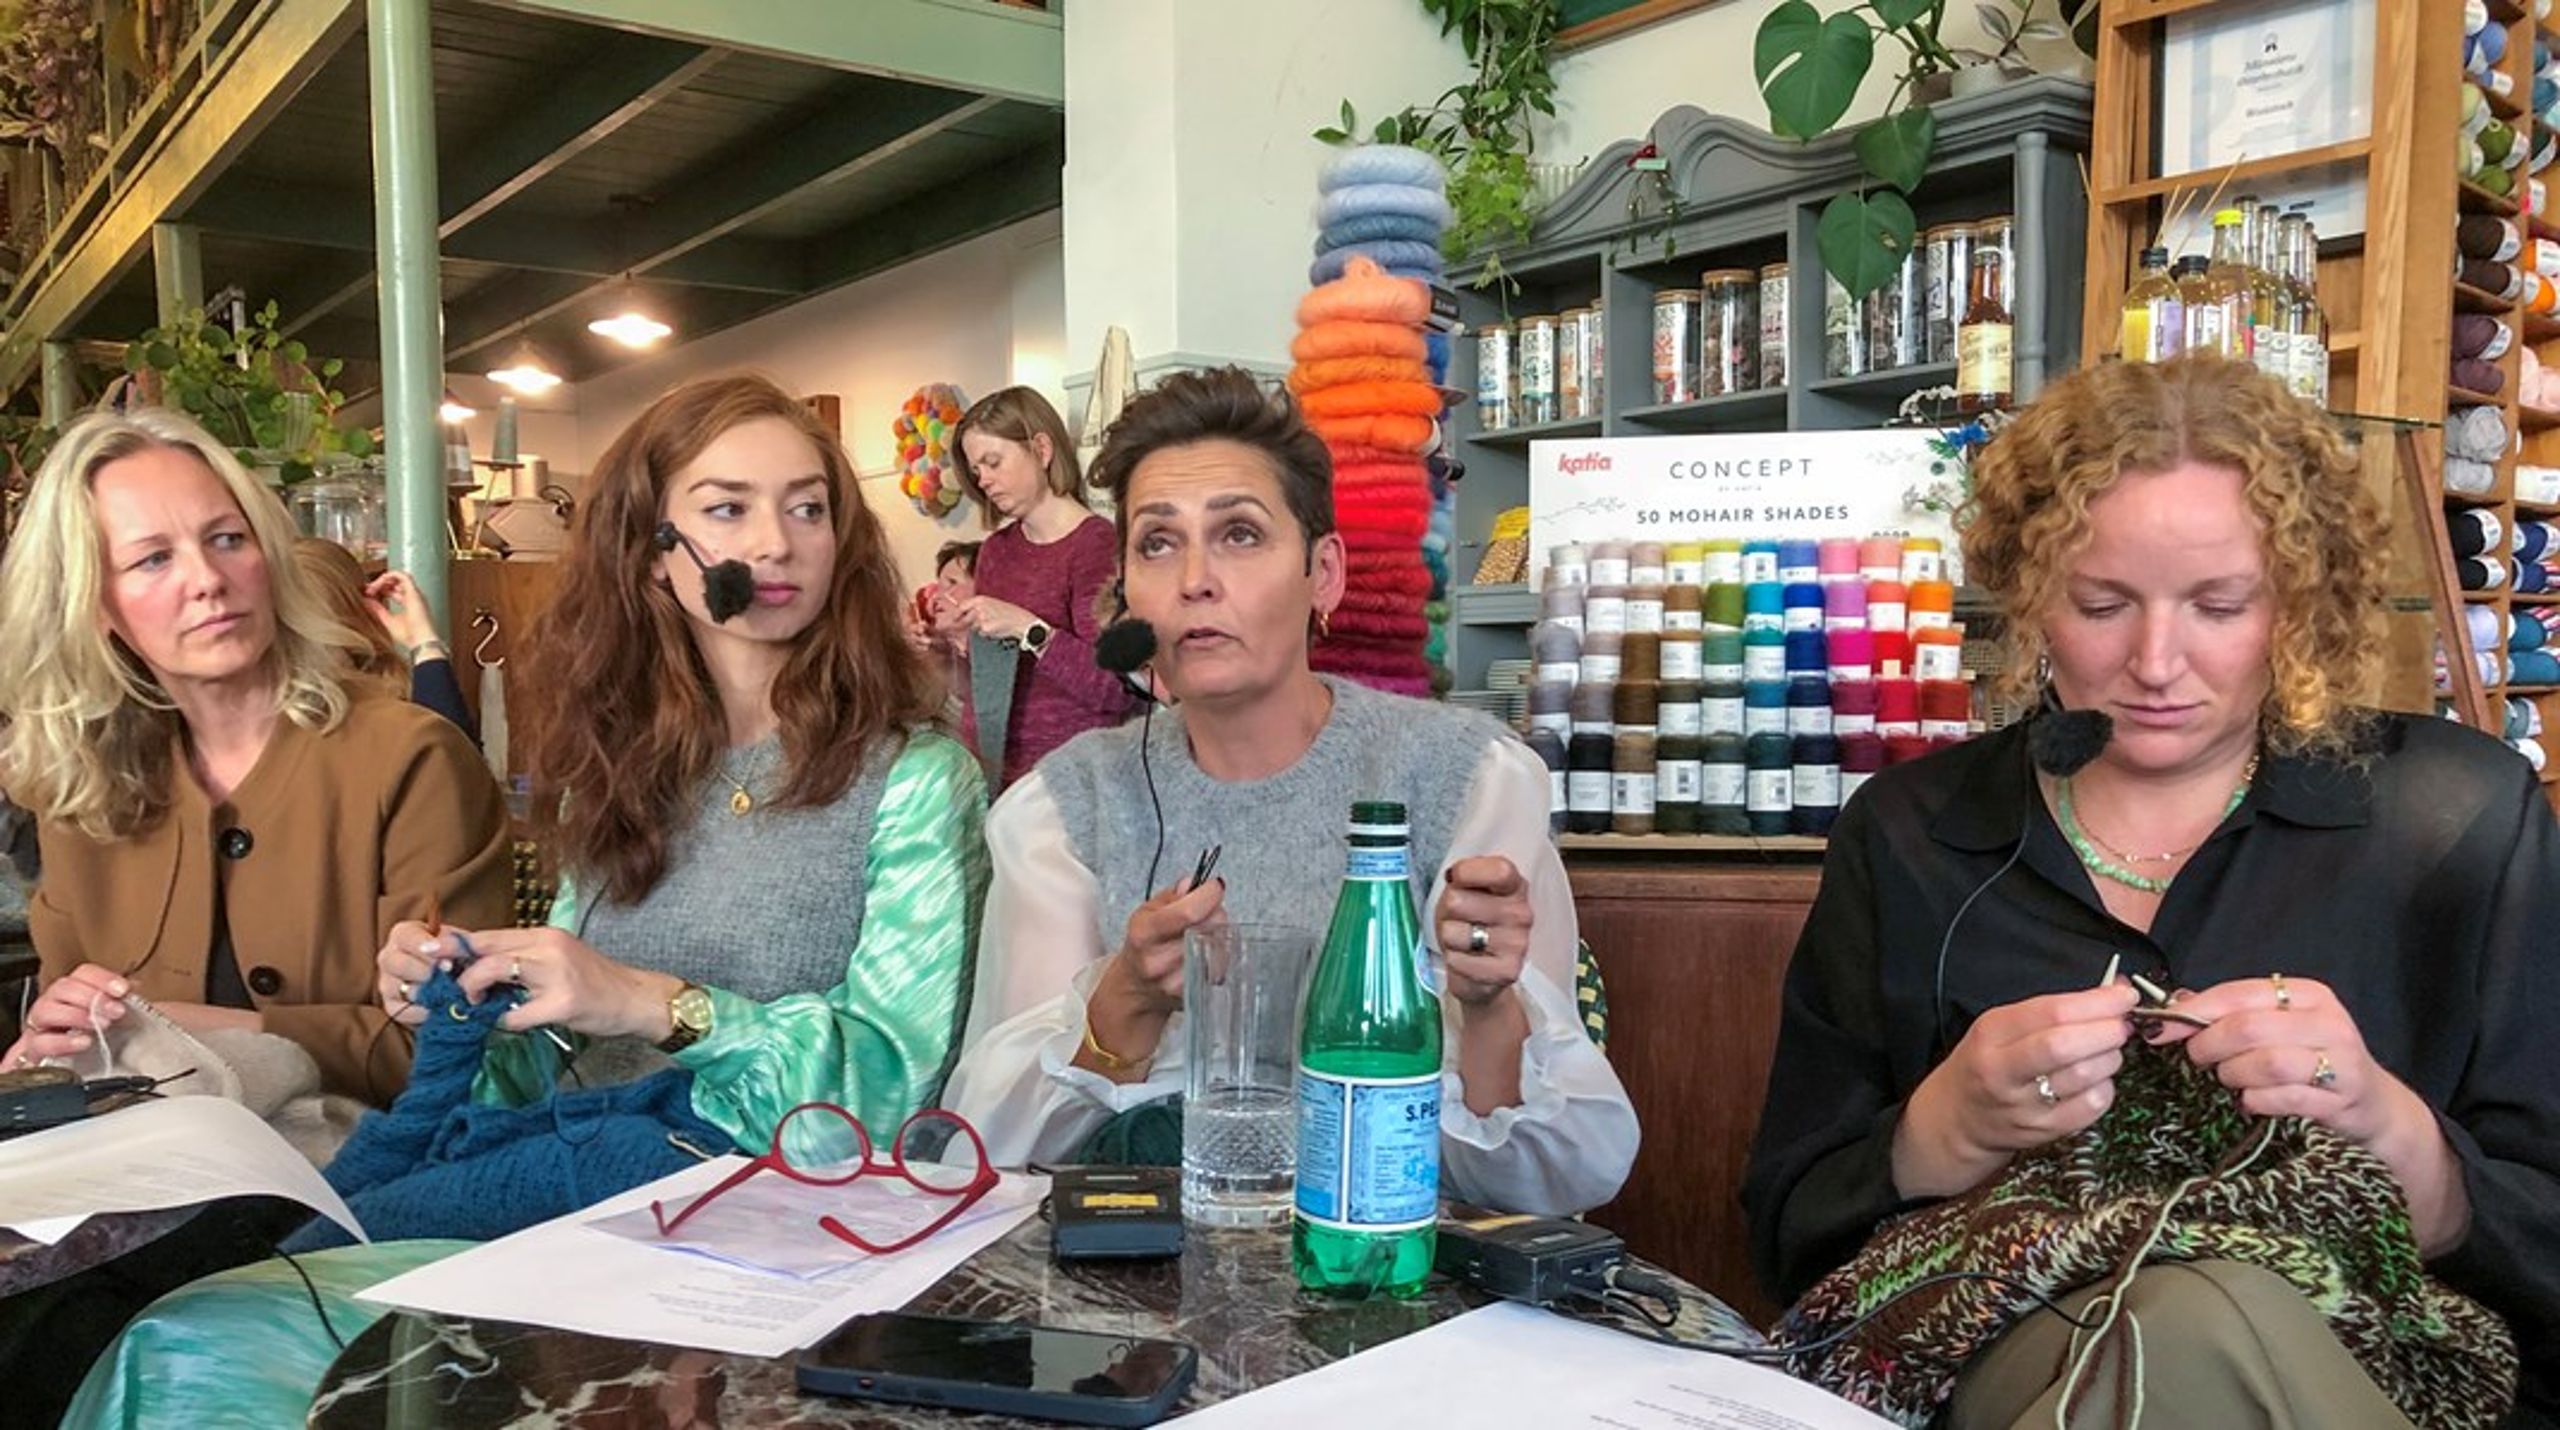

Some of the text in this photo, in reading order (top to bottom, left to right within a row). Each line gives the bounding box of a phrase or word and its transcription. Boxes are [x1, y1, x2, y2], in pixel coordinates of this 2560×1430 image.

[1558, 452, 1612, 476] katia
[1669, 457, 1813, 480] CONCEPT
[1636, 505, 1849, 524] 50 MOHAIR SHADES
